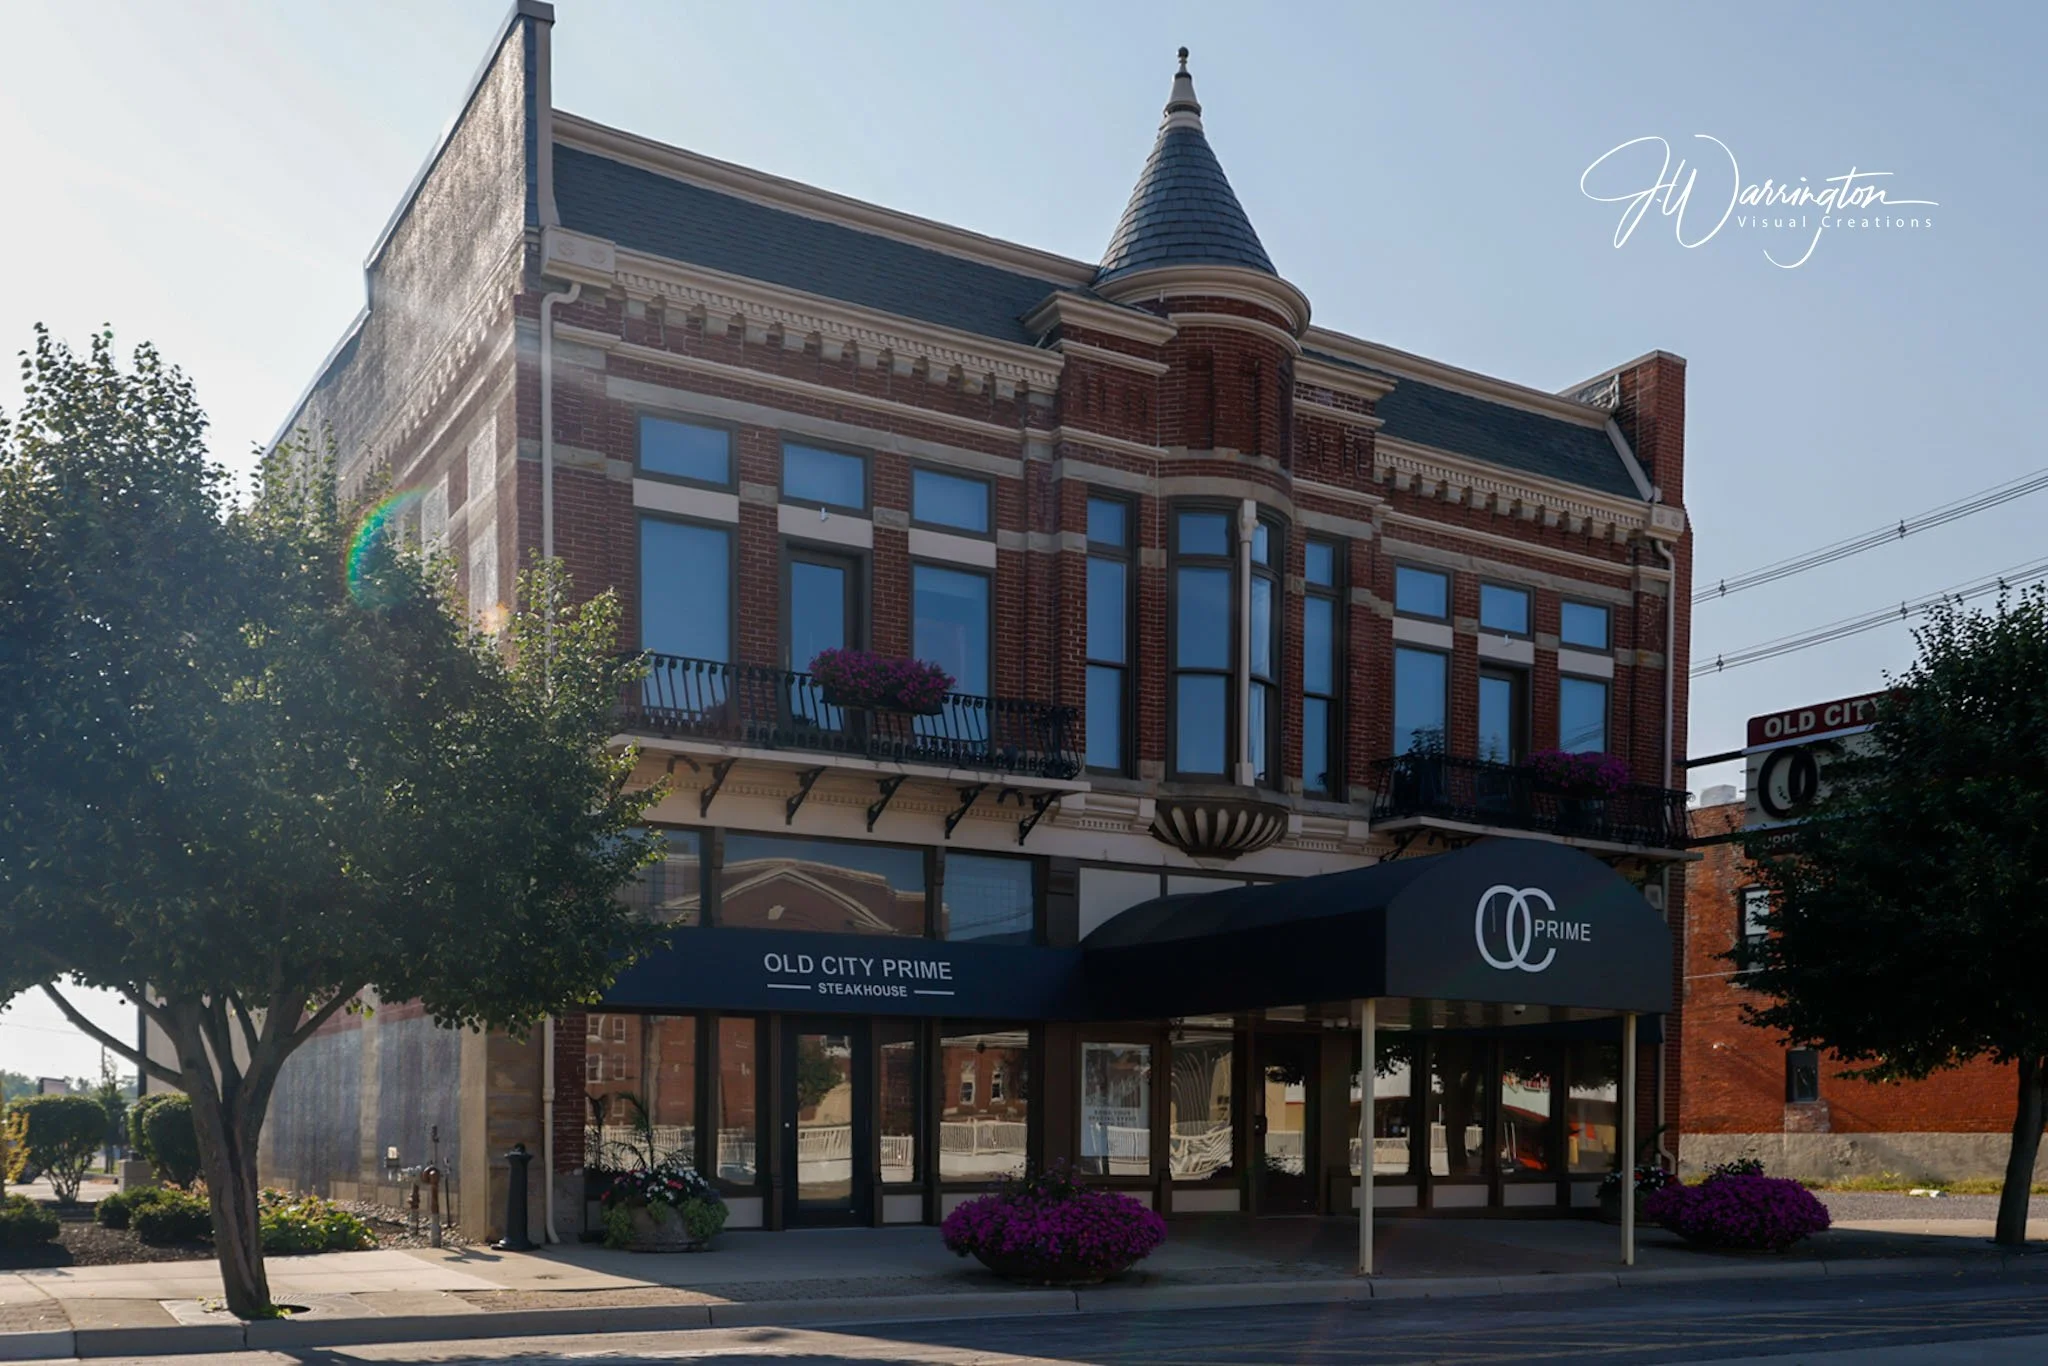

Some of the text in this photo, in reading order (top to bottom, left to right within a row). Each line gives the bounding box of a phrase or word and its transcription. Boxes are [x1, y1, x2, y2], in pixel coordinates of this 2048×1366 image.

[1763, 710, 1816, 738] OLD
[1534, 918, 1592, 942] PRIME
[764, 952, 953, 980] OLD CITY PRIME
[818, 982, 908, 998] STEAKHOUSE
